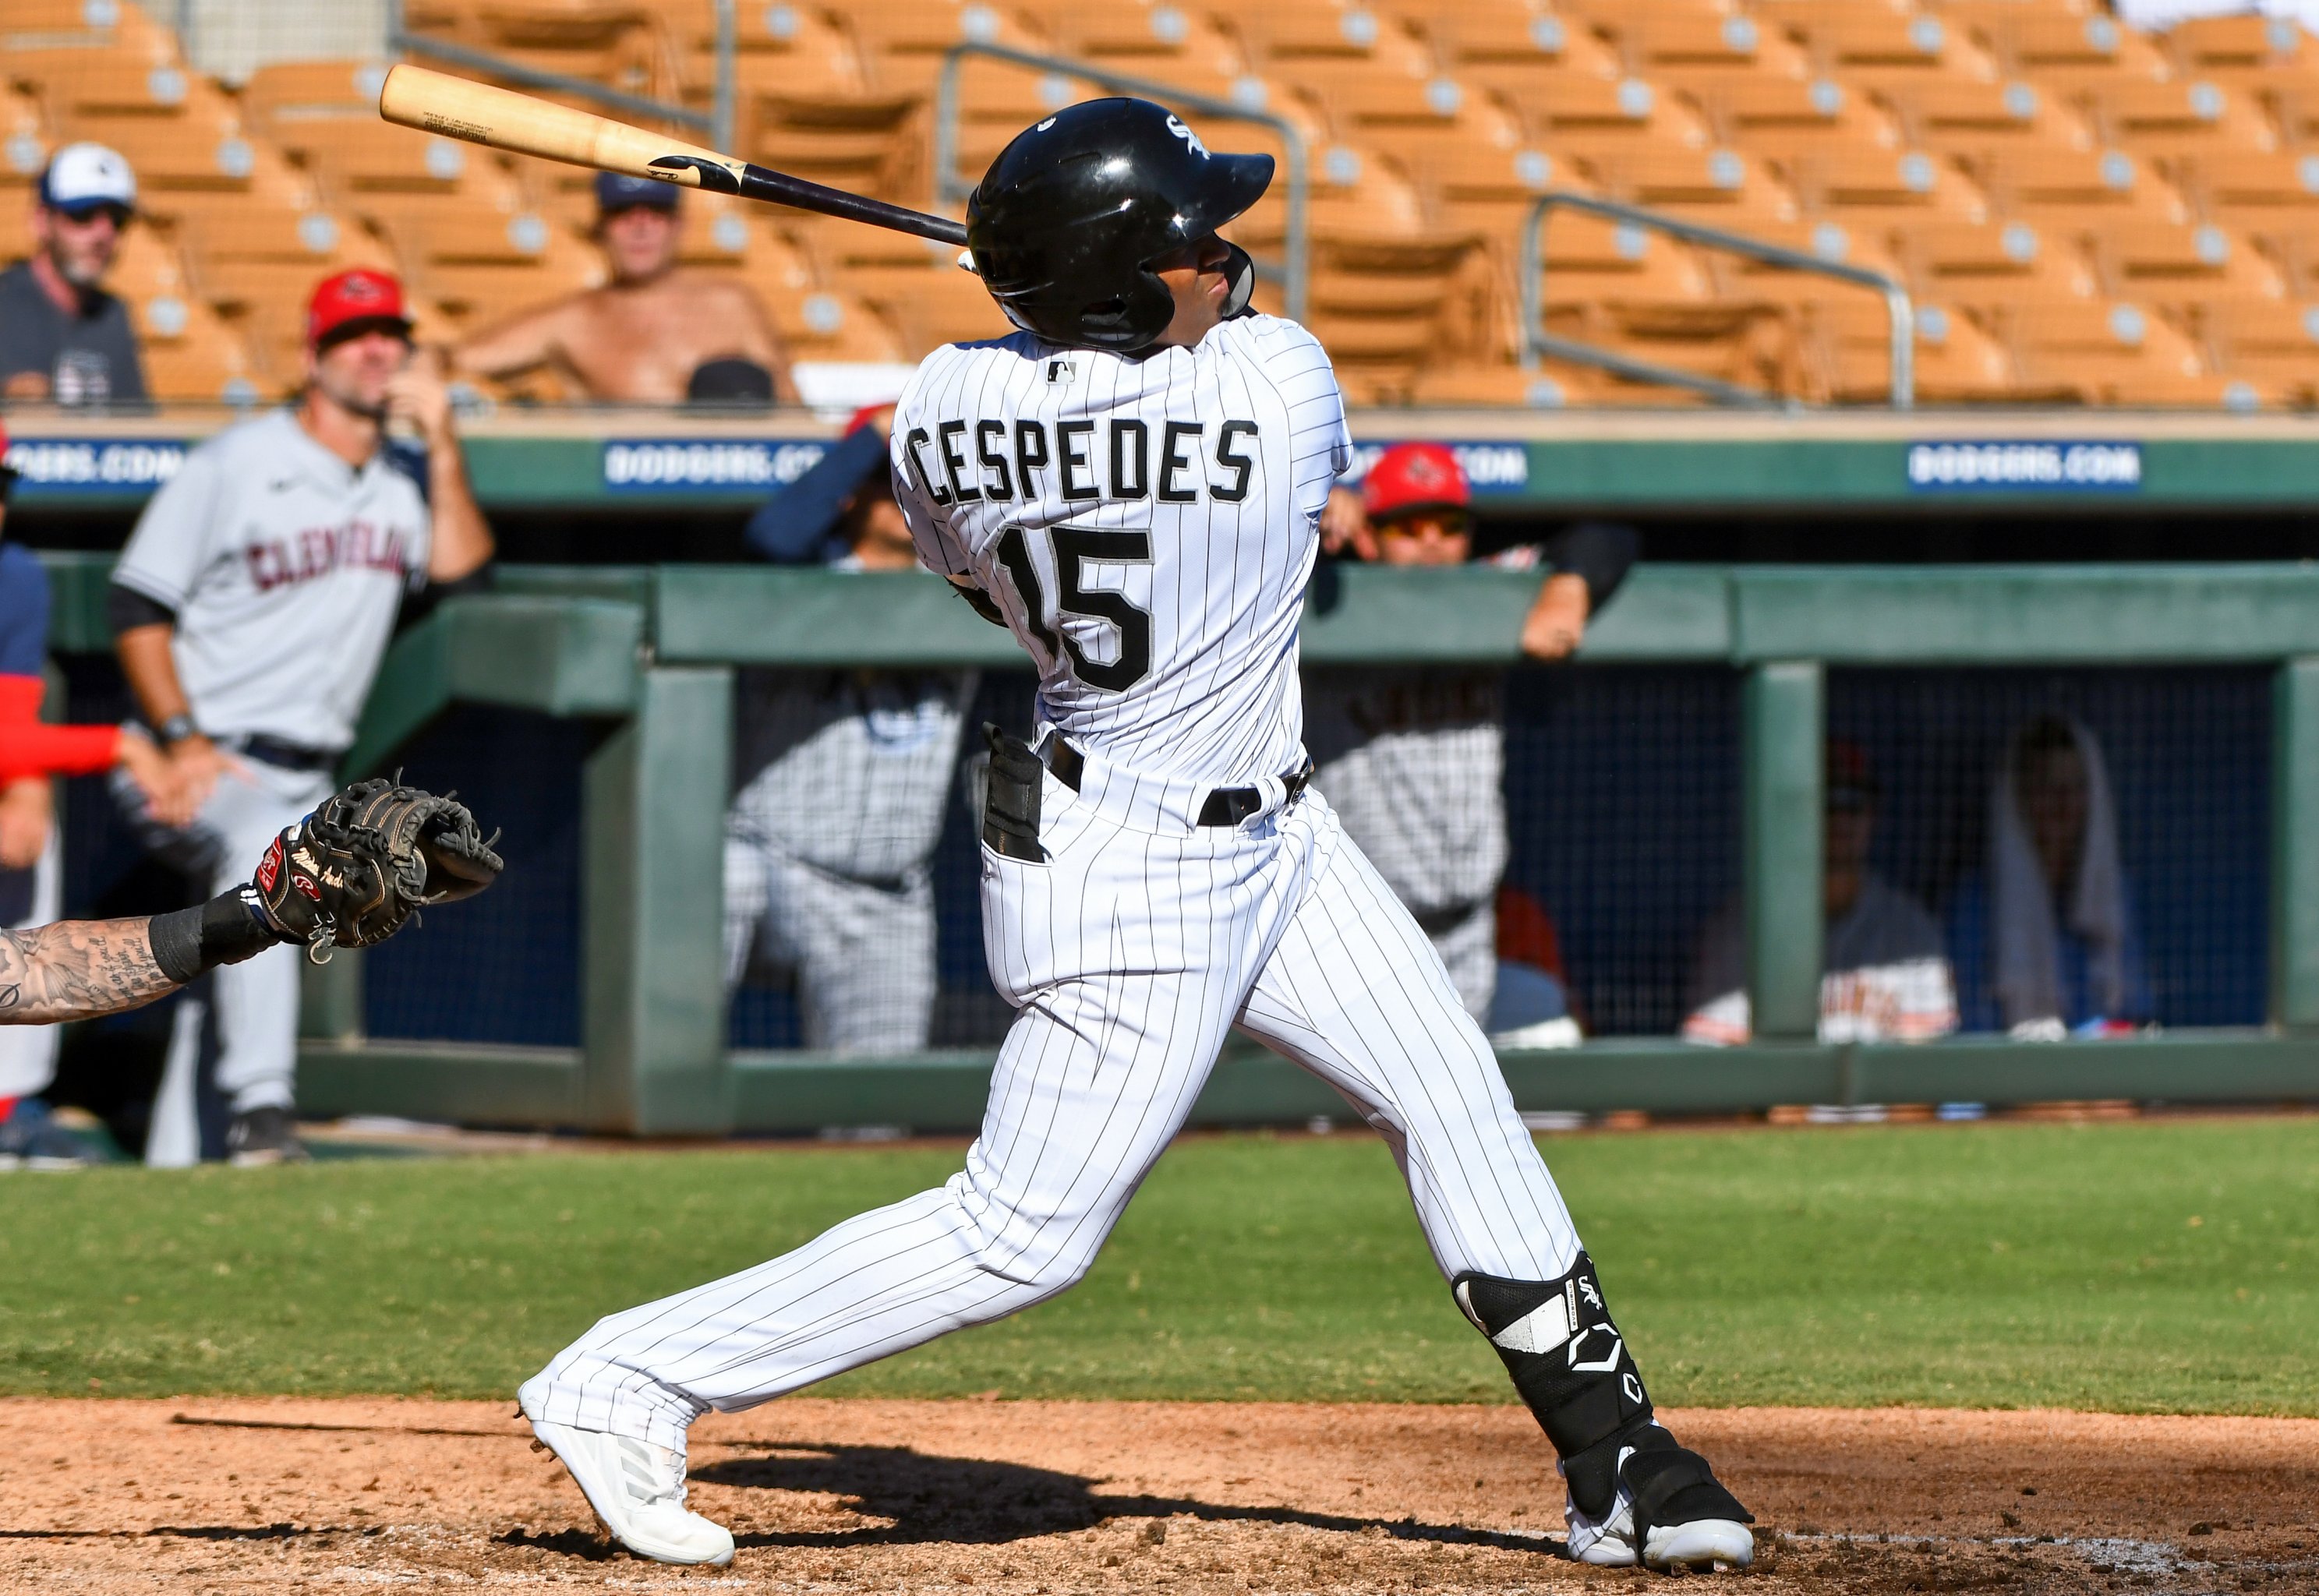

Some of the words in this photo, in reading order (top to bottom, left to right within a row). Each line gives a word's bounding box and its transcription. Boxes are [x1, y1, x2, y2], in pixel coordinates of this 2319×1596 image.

[904, 418, 1260, 507] CESPEDES
[1908, 443, 2140, 484] DODGERS.COM
[992, 524, 1154, 695] 15
